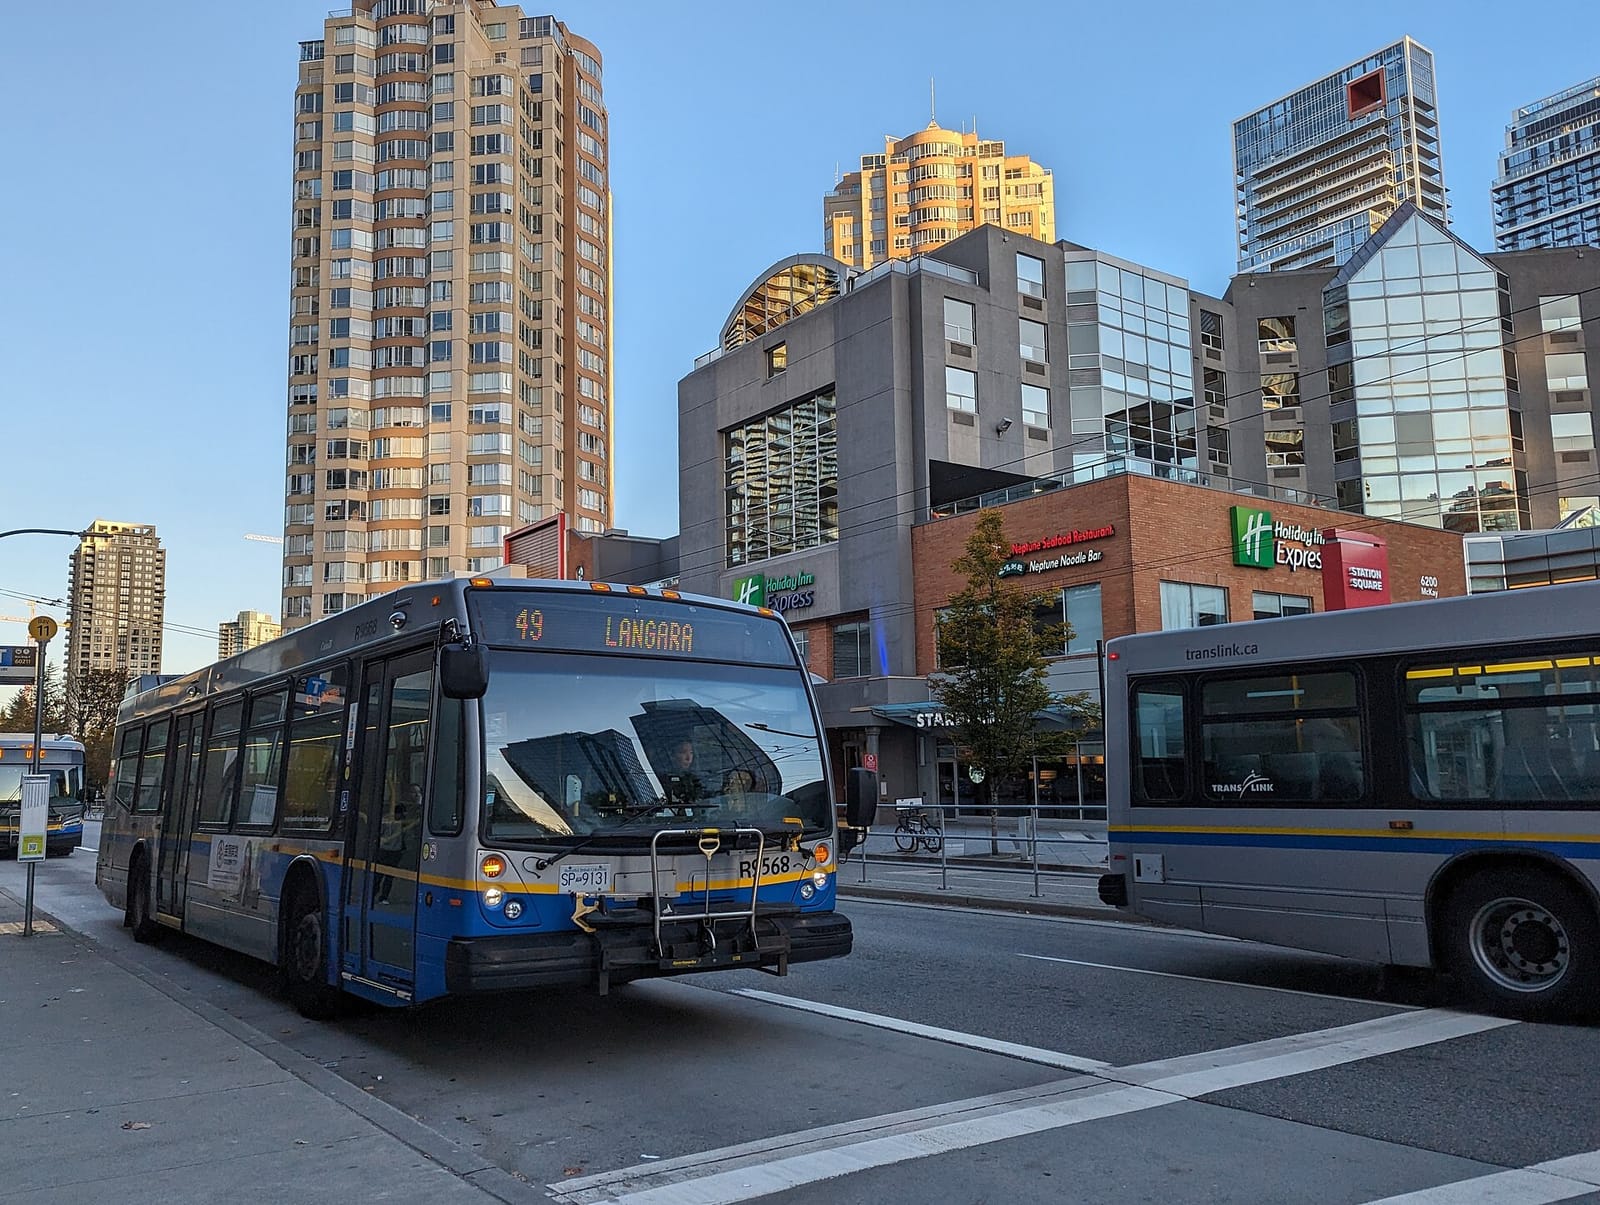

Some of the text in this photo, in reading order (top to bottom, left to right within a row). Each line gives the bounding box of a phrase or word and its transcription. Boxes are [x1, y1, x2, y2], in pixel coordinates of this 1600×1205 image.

[1011, 525, 1114, 556] Neptune Seafood Restaurant
[1274, 520, 1326, 547] Holiday In
[1029, 560, 1059, 574] Neptune
[1060, 552, 1087, 567] Noodle
[1276, 540, 1323, 572] Expres
[765, 570, 814, 593] Holiday Inn
[1350, 567, 1382, 579] STATION
[1420, 575, 1438, 588] 6200
[1350, 579, 1383, 591] SQUARE
[1420, 587, 1438, 599] McKay
[766, 590, 814, 613] Express
[37, 624, 49, 637] 11
[515, 608, 694, 652] 49 LANGARA
[1186, 643, 1259, 660] translink.ca
[26, 750, 46, 759] UC
